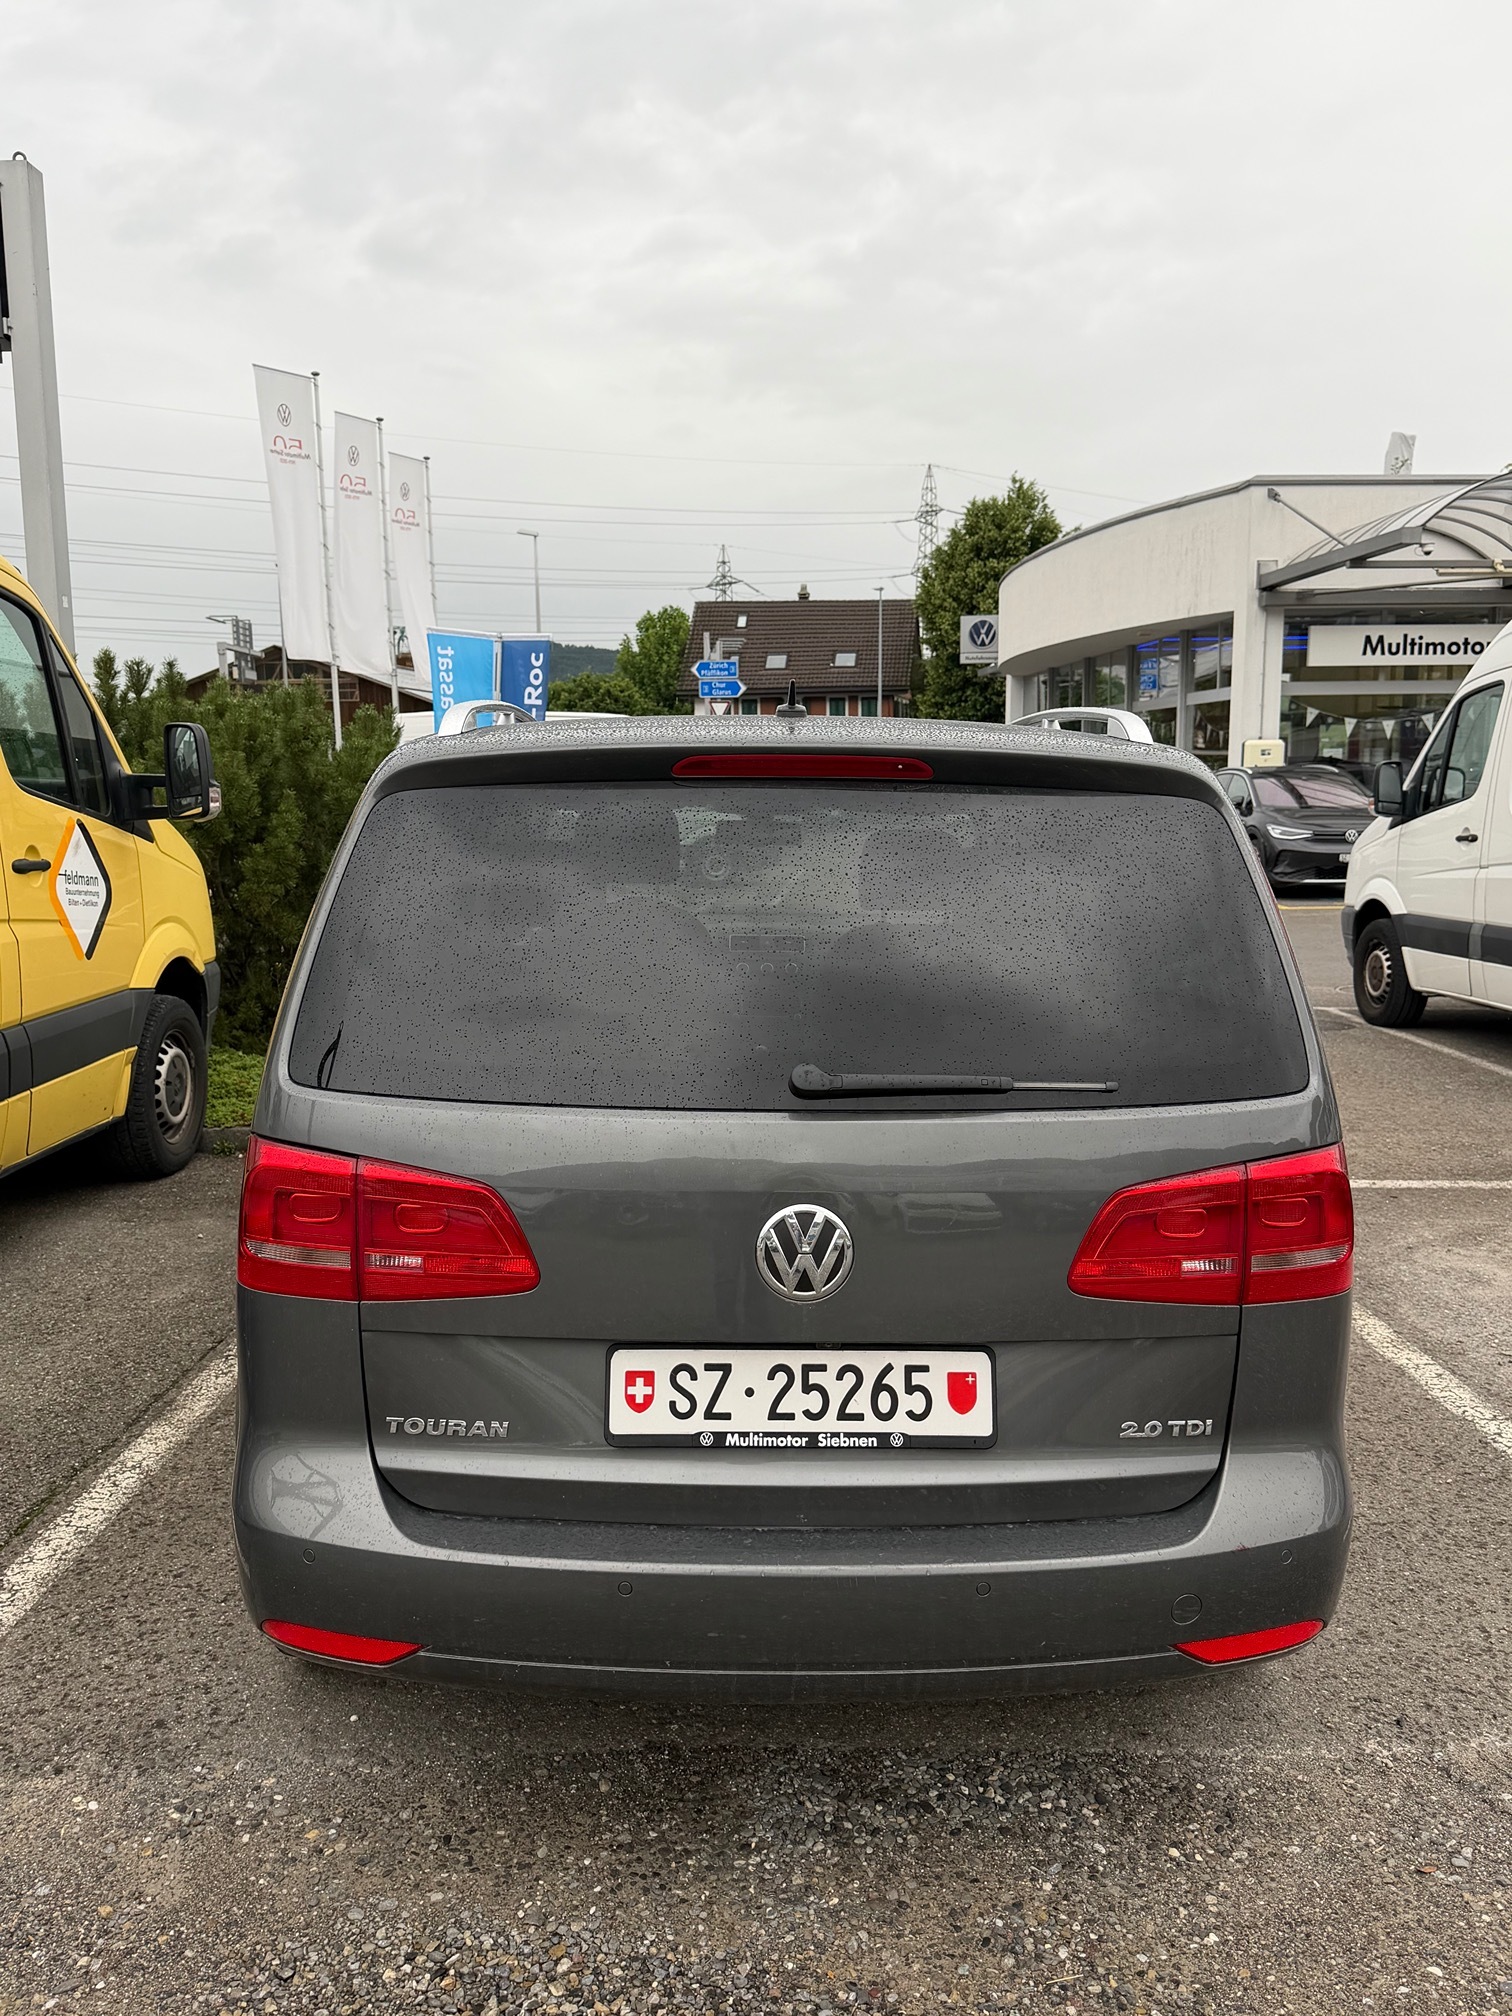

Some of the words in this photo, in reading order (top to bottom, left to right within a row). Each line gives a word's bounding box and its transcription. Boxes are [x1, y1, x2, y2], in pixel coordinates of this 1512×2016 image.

[1362, 633, 1491, 656] Multimoto
[523, 652, 544, 719] -Roc
[64, 869, 99, 887] feldmann
[385, 1416, 510, 1438] TOURAN
[1167, 1419, 1213, 1437] TDI
[725, 1432, 808, 1447] Multimotor
[817, 1433, 878, 1447] Siebnen
